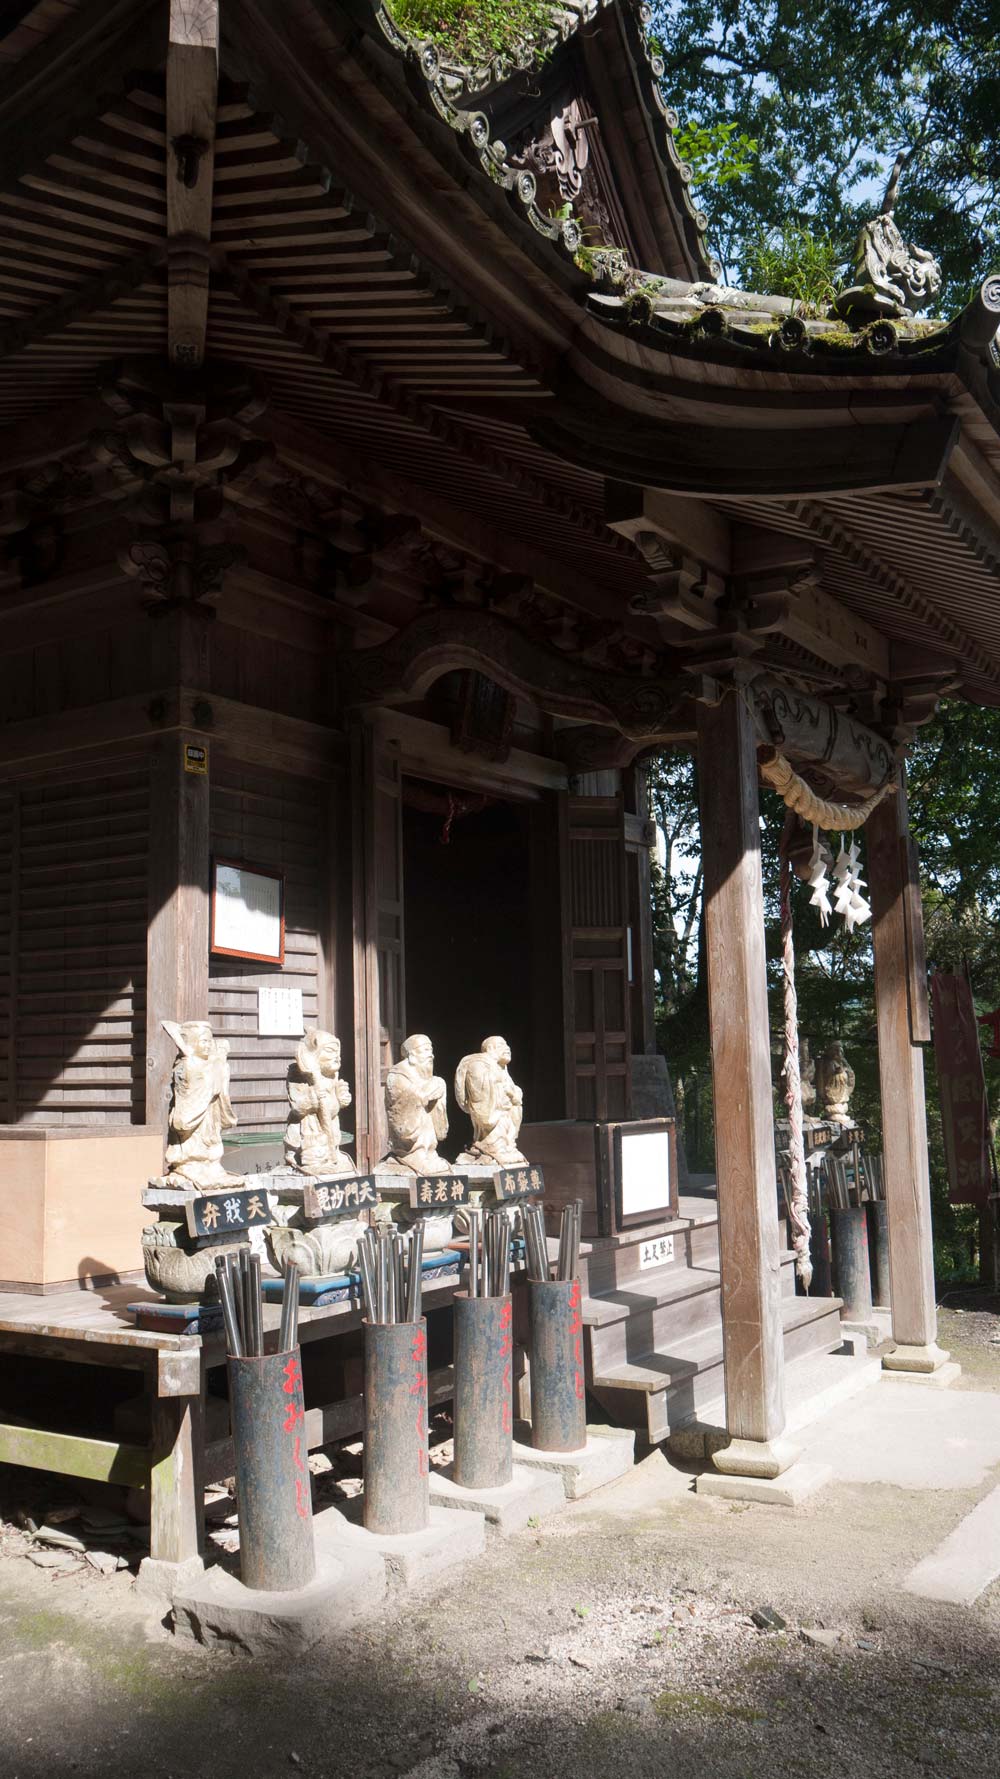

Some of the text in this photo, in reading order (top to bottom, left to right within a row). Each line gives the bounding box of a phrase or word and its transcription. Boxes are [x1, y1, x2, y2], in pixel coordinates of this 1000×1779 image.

[420, 1179, 464, 1204] 寿老神
[504, 1169, 541, 1194] 布袋尊
[315, 1180, 376, 1211] 毘沙門天
[643, 1239, 673, 1263] 土足禁止
[283, 1357, 308, 1519] おみくじ
